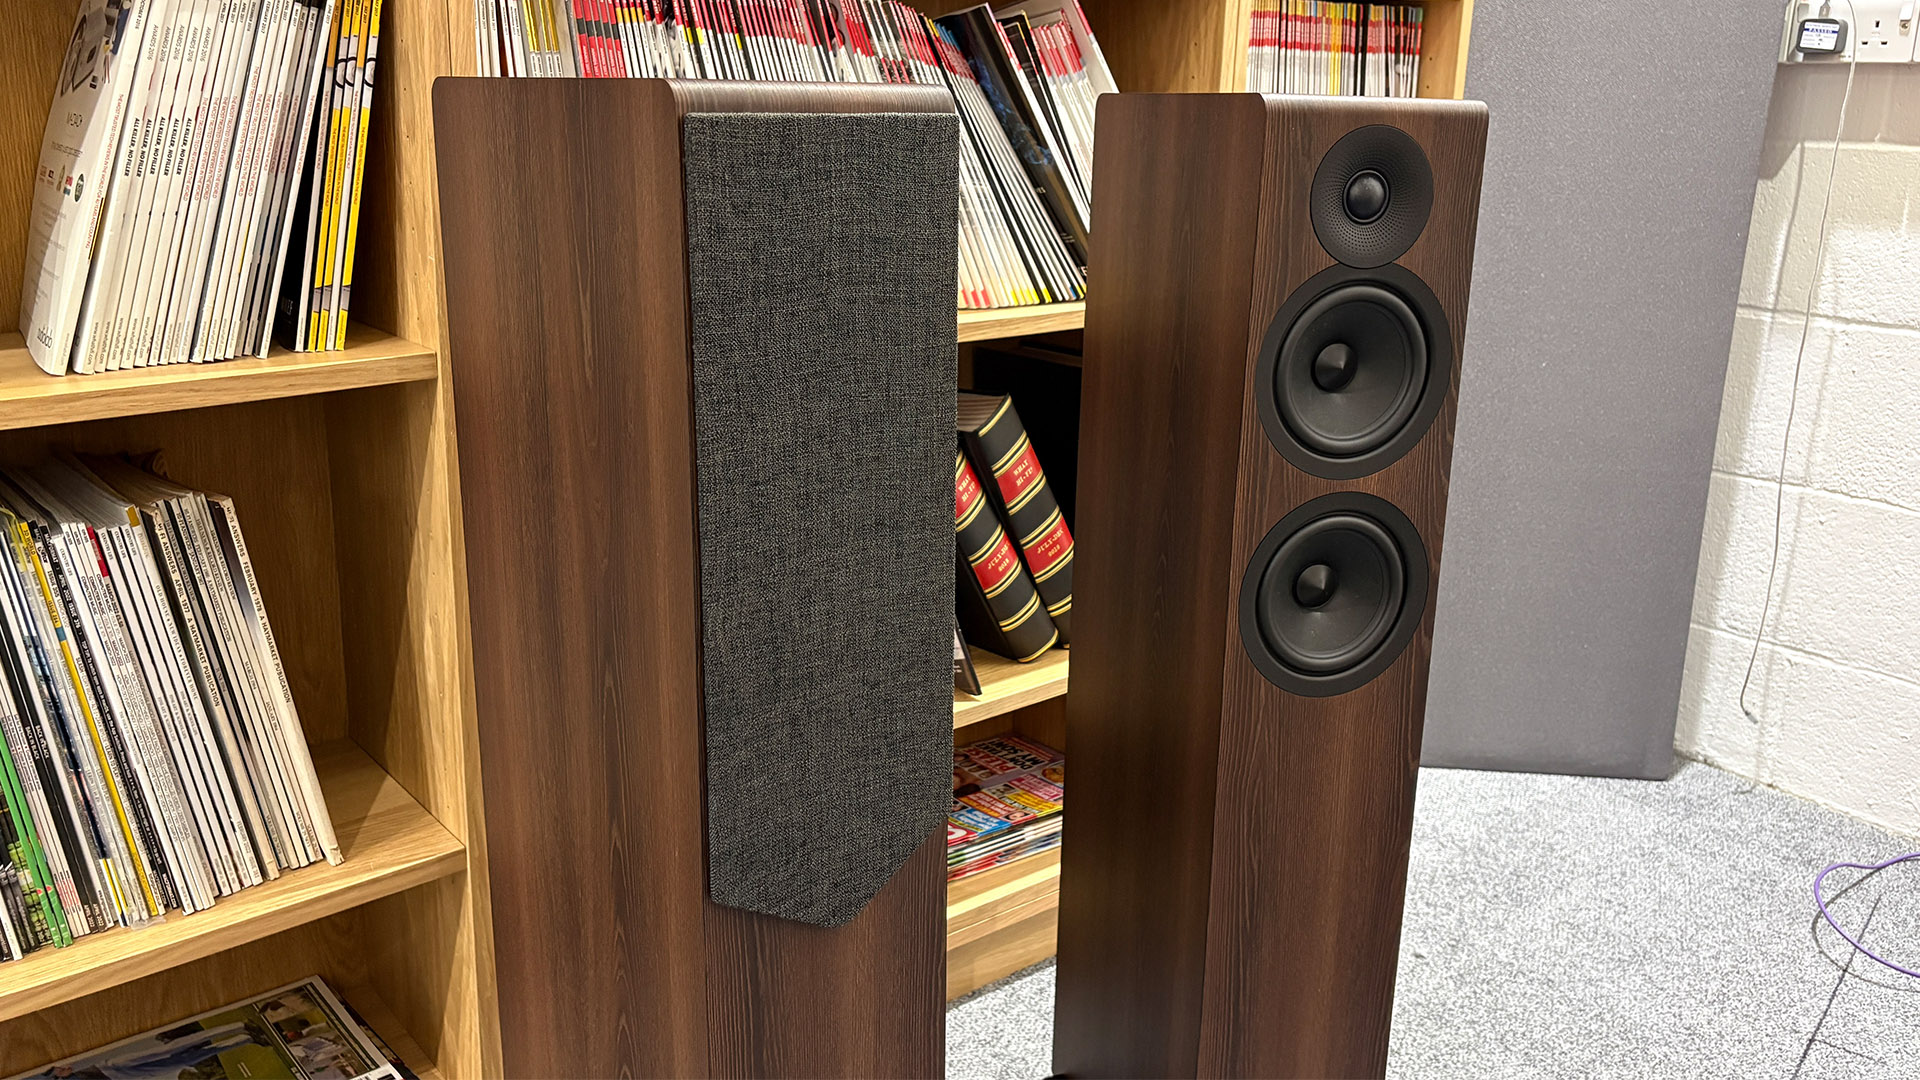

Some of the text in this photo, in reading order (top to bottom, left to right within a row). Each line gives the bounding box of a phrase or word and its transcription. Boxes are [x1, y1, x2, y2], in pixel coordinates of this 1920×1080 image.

[127, 149, 133, 158] NO
[139, 150, 145, 159] NO
[153, 147, 159, 156] NO
[167, 149, 173, 158] NO
[179, 148, 185, 157] NO
[124, 158, 132, 176] FILLER
[136, 159, 144, 177] FILLER
[176, 157, 184, 175] FILLER
[80, 575, 93, 601] COMPUTER
[88, 575, 101, 601] COMPUTER
[96, 573, 107, 598] COMPUTER
[231, 524, 245, 556] ANSWERS
[242, 561, 257, 595] FEBRUARY
[254, 597, 262, 611] 1978
[261, 622, 277, 661] HAYMARKET
[274, 662, 291, 702] PUBLICATION
[162, 541, 177, 574] ANSWERS
[174, 578, 184, 597] APRIL
[181, 599, 189, 613] 1977
[189, 624, 206, 663] HAYMARKET
[202, 665, 220, 706] PUBLICATION
[25, 726, 33, 739] BACK
[31, 744, 40, 760] BLACK
[35, 724, 43, 738] BACK
[41, 742, 50, 759] BLACK
